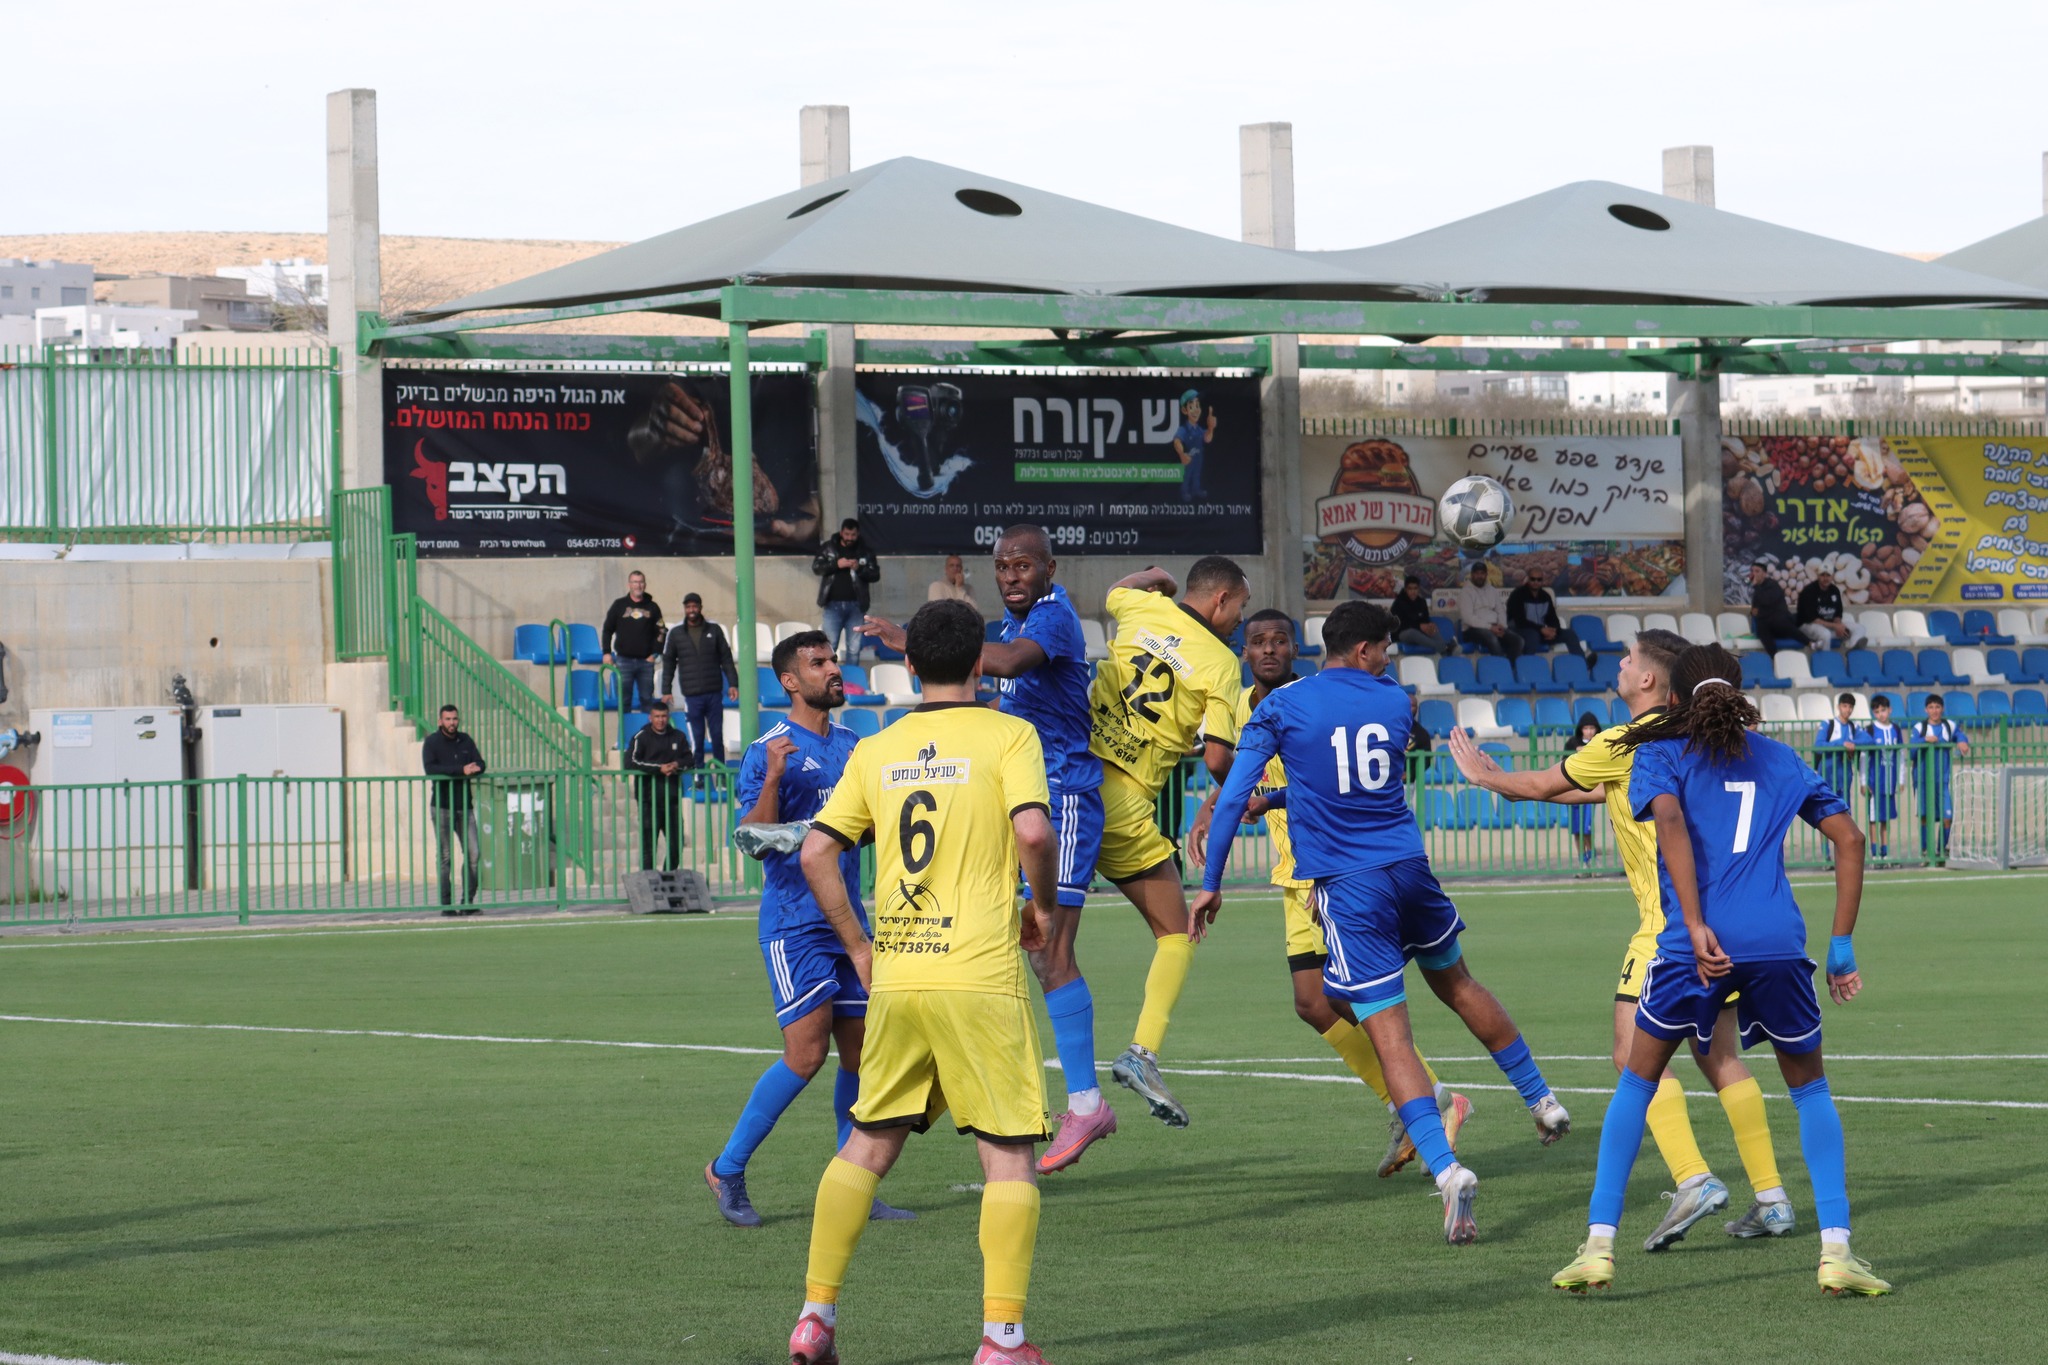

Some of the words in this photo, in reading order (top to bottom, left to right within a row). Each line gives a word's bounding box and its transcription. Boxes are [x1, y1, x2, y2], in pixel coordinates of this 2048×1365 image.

[396, 385, 439, 404] בדיוק
[444, 383, 508, 403] מבשלים
[513, 387, 555, 403] היפה
[560, 385, 596, 404] הגול
[600, 389, 625, 404] את
[389, 405, 486, 430] המושלם.
[493, 411, 549, 430] הנתח
[555, 412, 591, 431] כמו
[1013, 397, 1180, 459] ש.קורח
[1042, 450, 1063, 459] רשום
[1064, 449, 1083, 461] קבלן
[1467, 443, 1539, 463] שערים
[1555, 448, 1599, 468] שפע
[1020, 465, 1048, 478] נזילות
[1050, 467, 1080, 478] ואיתור
[1082, 465, 1138, 479] לאינסטלציה
[1140, 467, 1181, 479] המומחים
[1614, 454, 1666, 482] שנדע
[1983, 466, 2023, 484] טובה
[448, 461, 567, 503] הקצב
[1549, 476, 1590, 497] כמו
[1602, 483, 1669, 514] בדיוק
[448, 509, 473, 520] בשר
[475, 510, 505, 520] מוצרי
[507, 510, 541, 522] ושיווק
[902, 504, 936, 515] סתימות
[938, 504, 969, 515] פתיחת
[983, 504, 1002, 515] הרס
[1005, 502, 1024, 515] ללא
[1027, 504, 1045, 515] ביוב
[1047, 504, 1070, 515] צנרת
[1073, 504, 1095, 518] תיקון
[1109, 504, 1149, 518] מתקדמת
[1198, 502, 1224, 516] נזילות
[1227, 504, 1251, 516] איתור
[1321, 502, 1358, 527] אמא
[1360, 500, 1383, 520] של
[1388, 501, 1432, 527] הכריך
[1776, 498, 1849, 523] אדרי
[1514, 503, 1599, 540] מפנקי
[2003, 514, 2028, 532] עם
[1089, 528, 1139, 545] לפרטים:
[1781, 523, 1840, 546] באיזור
[1846, 515, 1884, 546] הזול
[437, 539, 460, 549] מתחם
[479, 539, 499, 549] הבית
[500, 539, 510, 549] עד
[512, 539, 546, 549] משלוחים
[567, 538, 621, 549] 054-657-1735
[1345, 537, 1365, 557] שוק
[1382, 537, 1408, 561] עושים
[1364, 548, 1381, 561] לכם
[1966, 550, 2017, 574] טובים!
[2021, 562, 2048, 579] הכי
[1120, 651, 1175, 725] 12
[1330, 723, 1391, 794] 16
[891, 767, 921, 782] שמש
[924, 763, 957, 779] שניצל
[1724, 781, 1756, 854] 7
[899, 789, 938, 874] 6
[912, 916, 940, 926] שירותי
[1621, 957, 1636, 985] 4
